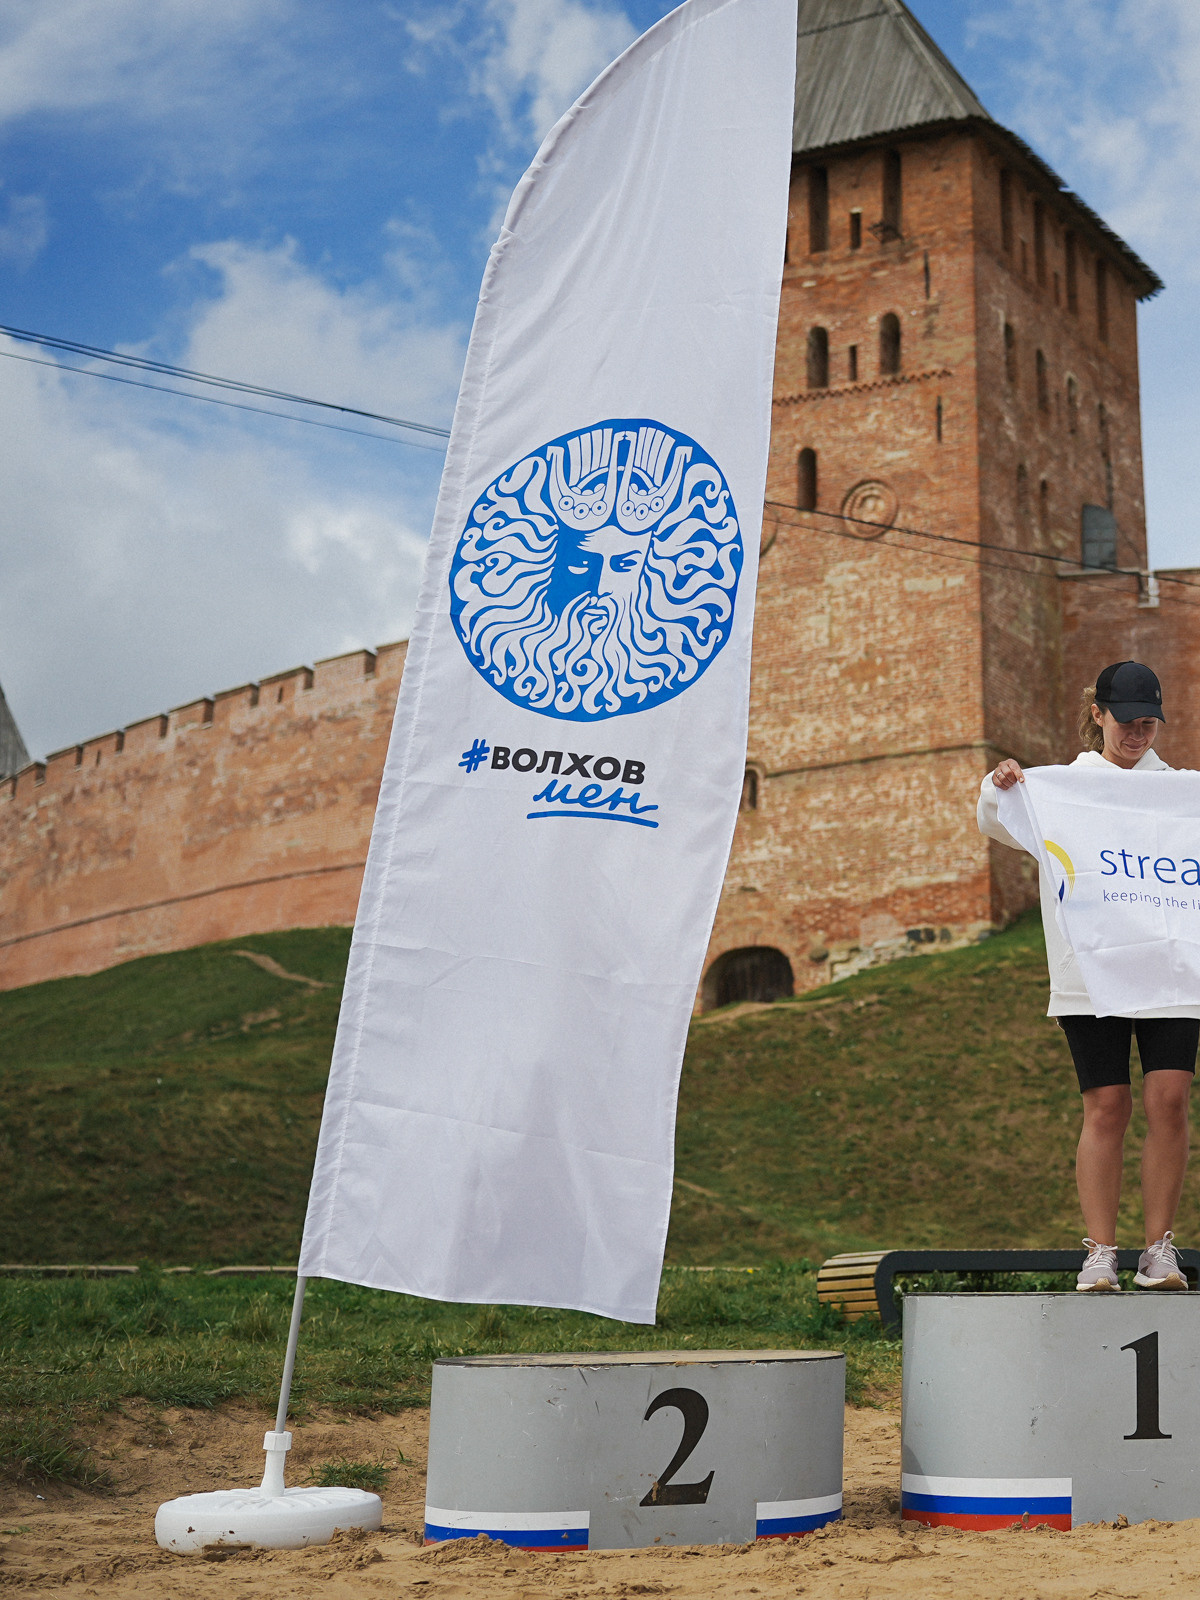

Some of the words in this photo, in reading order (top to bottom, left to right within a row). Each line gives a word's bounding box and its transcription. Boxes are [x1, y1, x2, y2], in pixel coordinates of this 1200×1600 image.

[458, 738, 646, 785] #ВОЛХОВ
[1103, 889, 1161, 908] keeping
[1165, 896, 1187, 910] the
[1121, 1331, 1173, 1441] 1
[639, 1387, 716, 1508] 2
